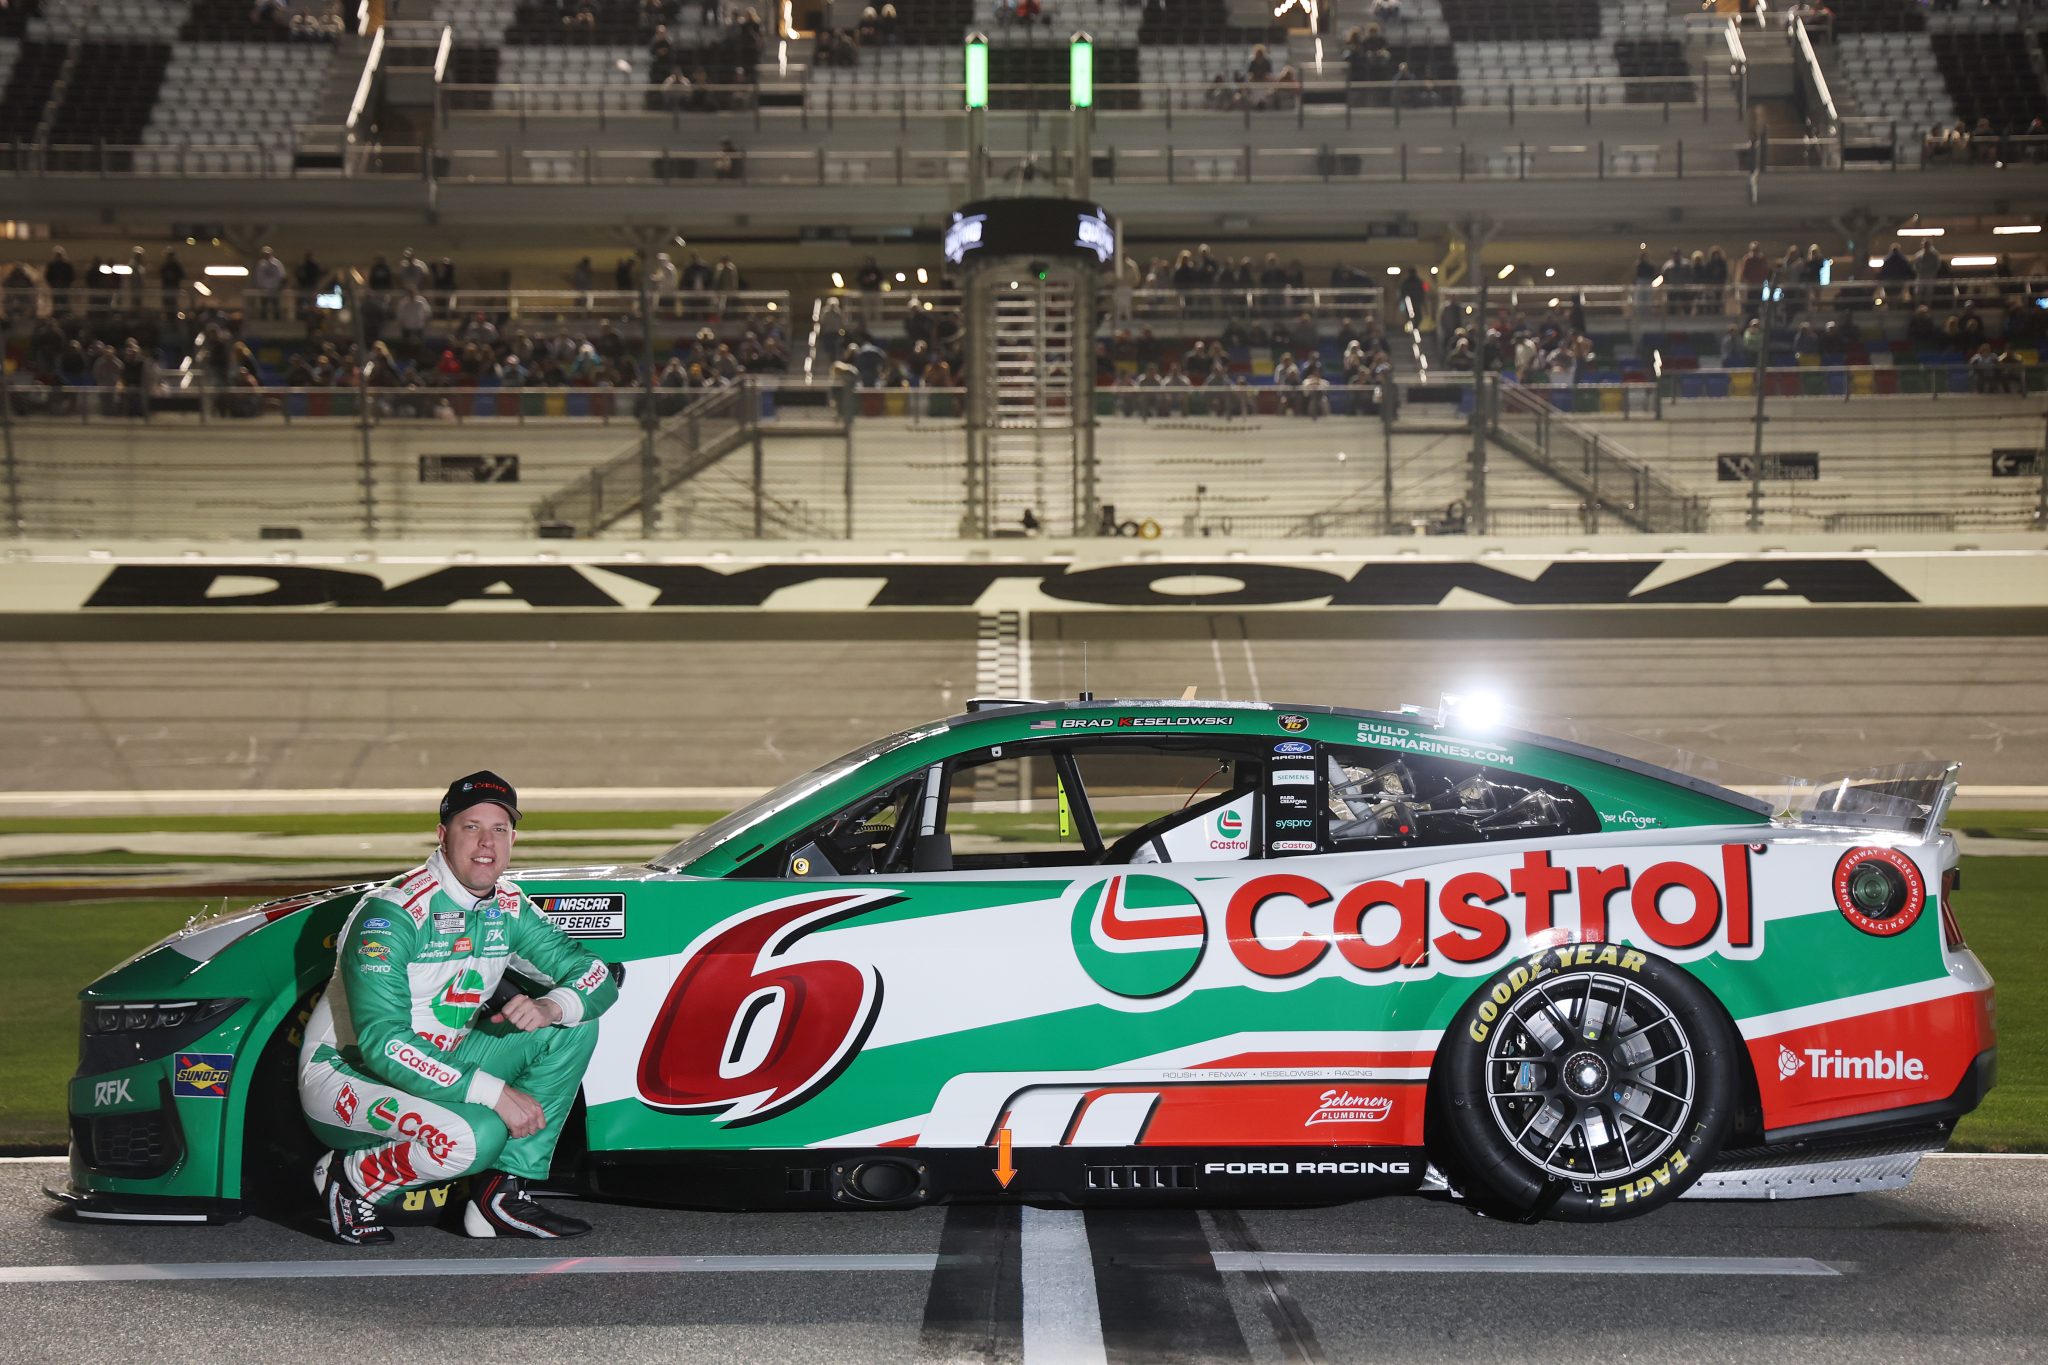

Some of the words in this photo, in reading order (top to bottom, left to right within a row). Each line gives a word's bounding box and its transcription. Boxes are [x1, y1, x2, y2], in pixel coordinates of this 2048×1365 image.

[82, 560, 1922, 607] DAYTONA
[1062, 719, 1113, 728] BRAD
[1118, 717, 1233, 727] KESELOWSKI
[1358, 722, 1410, 737] BUILD
[1280, 743, 1304, 752] Ford
[1356, 731, 1514, 765] SUBMARINES.COM
[1275, 819, 1312, 829] syspro
[1618, 810, 1656, 829] Kroger
[1210, 840, 1249, 850] Castrol
[1845, 849, 1878, 870] FENWAY
[1891, 854, 1919, 913] KESELOWSKI
[558, 898, 611, 911] NASCAR
[1840, 881, 1856, 914] ROUSH
[1225, 842, 1752, 978] Castrol
[567, 916, 611, 928] SERIES
[1861, 918, 1904, 930] RACING
[635, 888, 911, 1128] 6
[399, 1048, 457, 1086] Castrol
[1804, 1049, 1924, 1080] Trimble
[178, 1070, 230, 1082] SUNOCO
[94, 1078, 135, 1107] RFK
[1320, 1089, 1392, 1110] Solomon
[1321, 1111, 1375, 1119] PLUMBING
[1204, 1162, 1289, 1174] FORD
[1295, 1162, 1410, 1174] RACING
[1600, 1149, 1689, 1207] EAGLE
